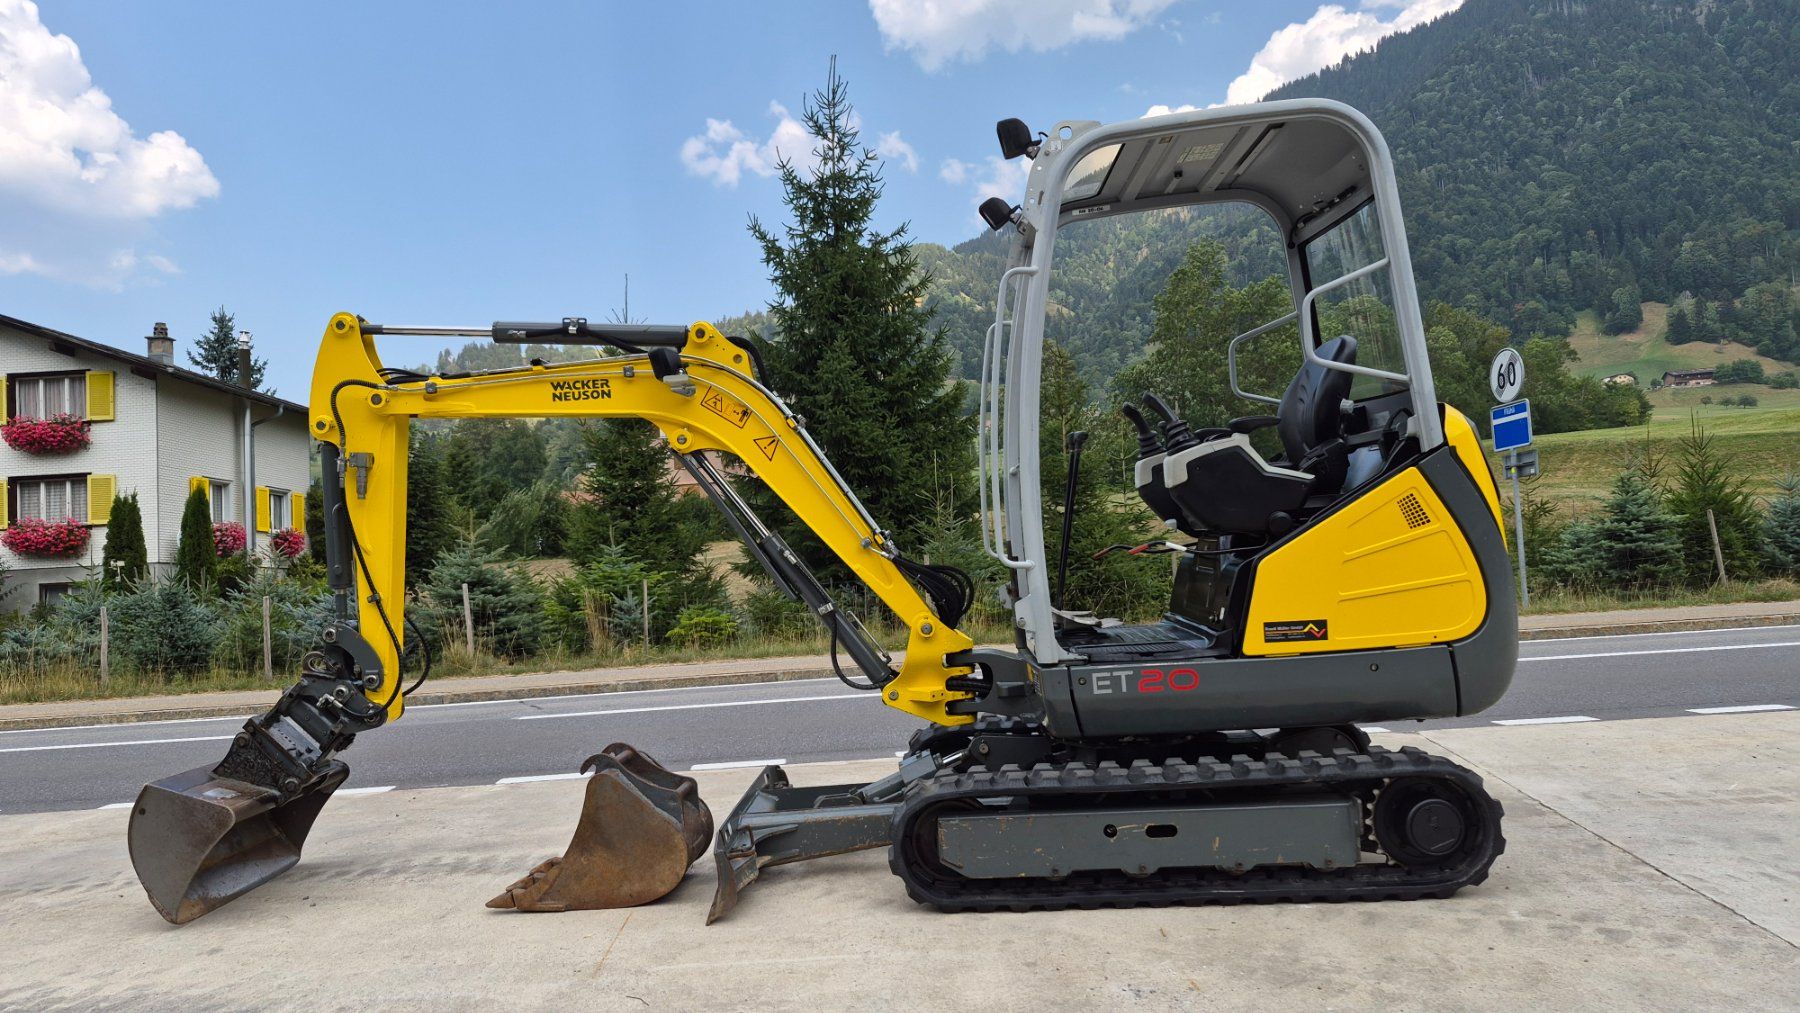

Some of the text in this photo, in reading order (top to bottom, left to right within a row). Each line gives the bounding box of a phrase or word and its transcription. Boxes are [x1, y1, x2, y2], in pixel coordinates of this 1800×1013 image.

[550, 379, 611, 392] WACKER
[1497, 361, 1516, 390] 60
[552, 389, 612, 402] NEUSON
[1091, 668, 1200, 695] ET20
